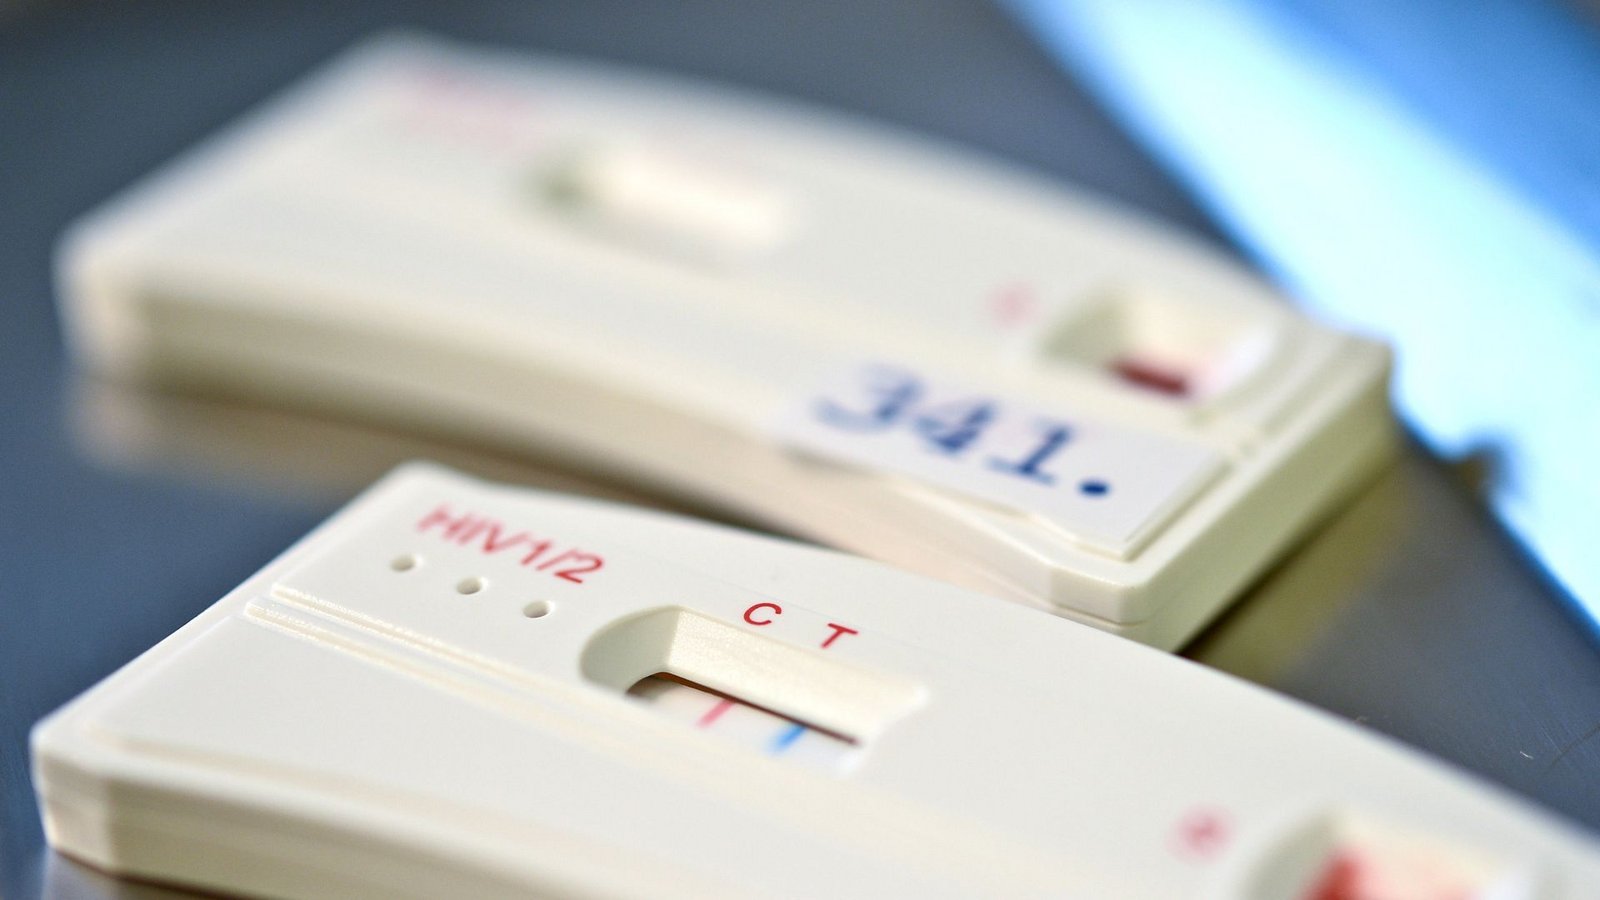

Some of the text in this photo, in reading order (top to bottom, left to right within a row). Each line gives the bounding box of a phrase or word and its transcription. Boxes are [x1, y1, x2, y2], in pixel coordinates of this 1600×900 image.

[417, 505, 606, 584] HIV1/2
[743, 602, 858, 649] C T
